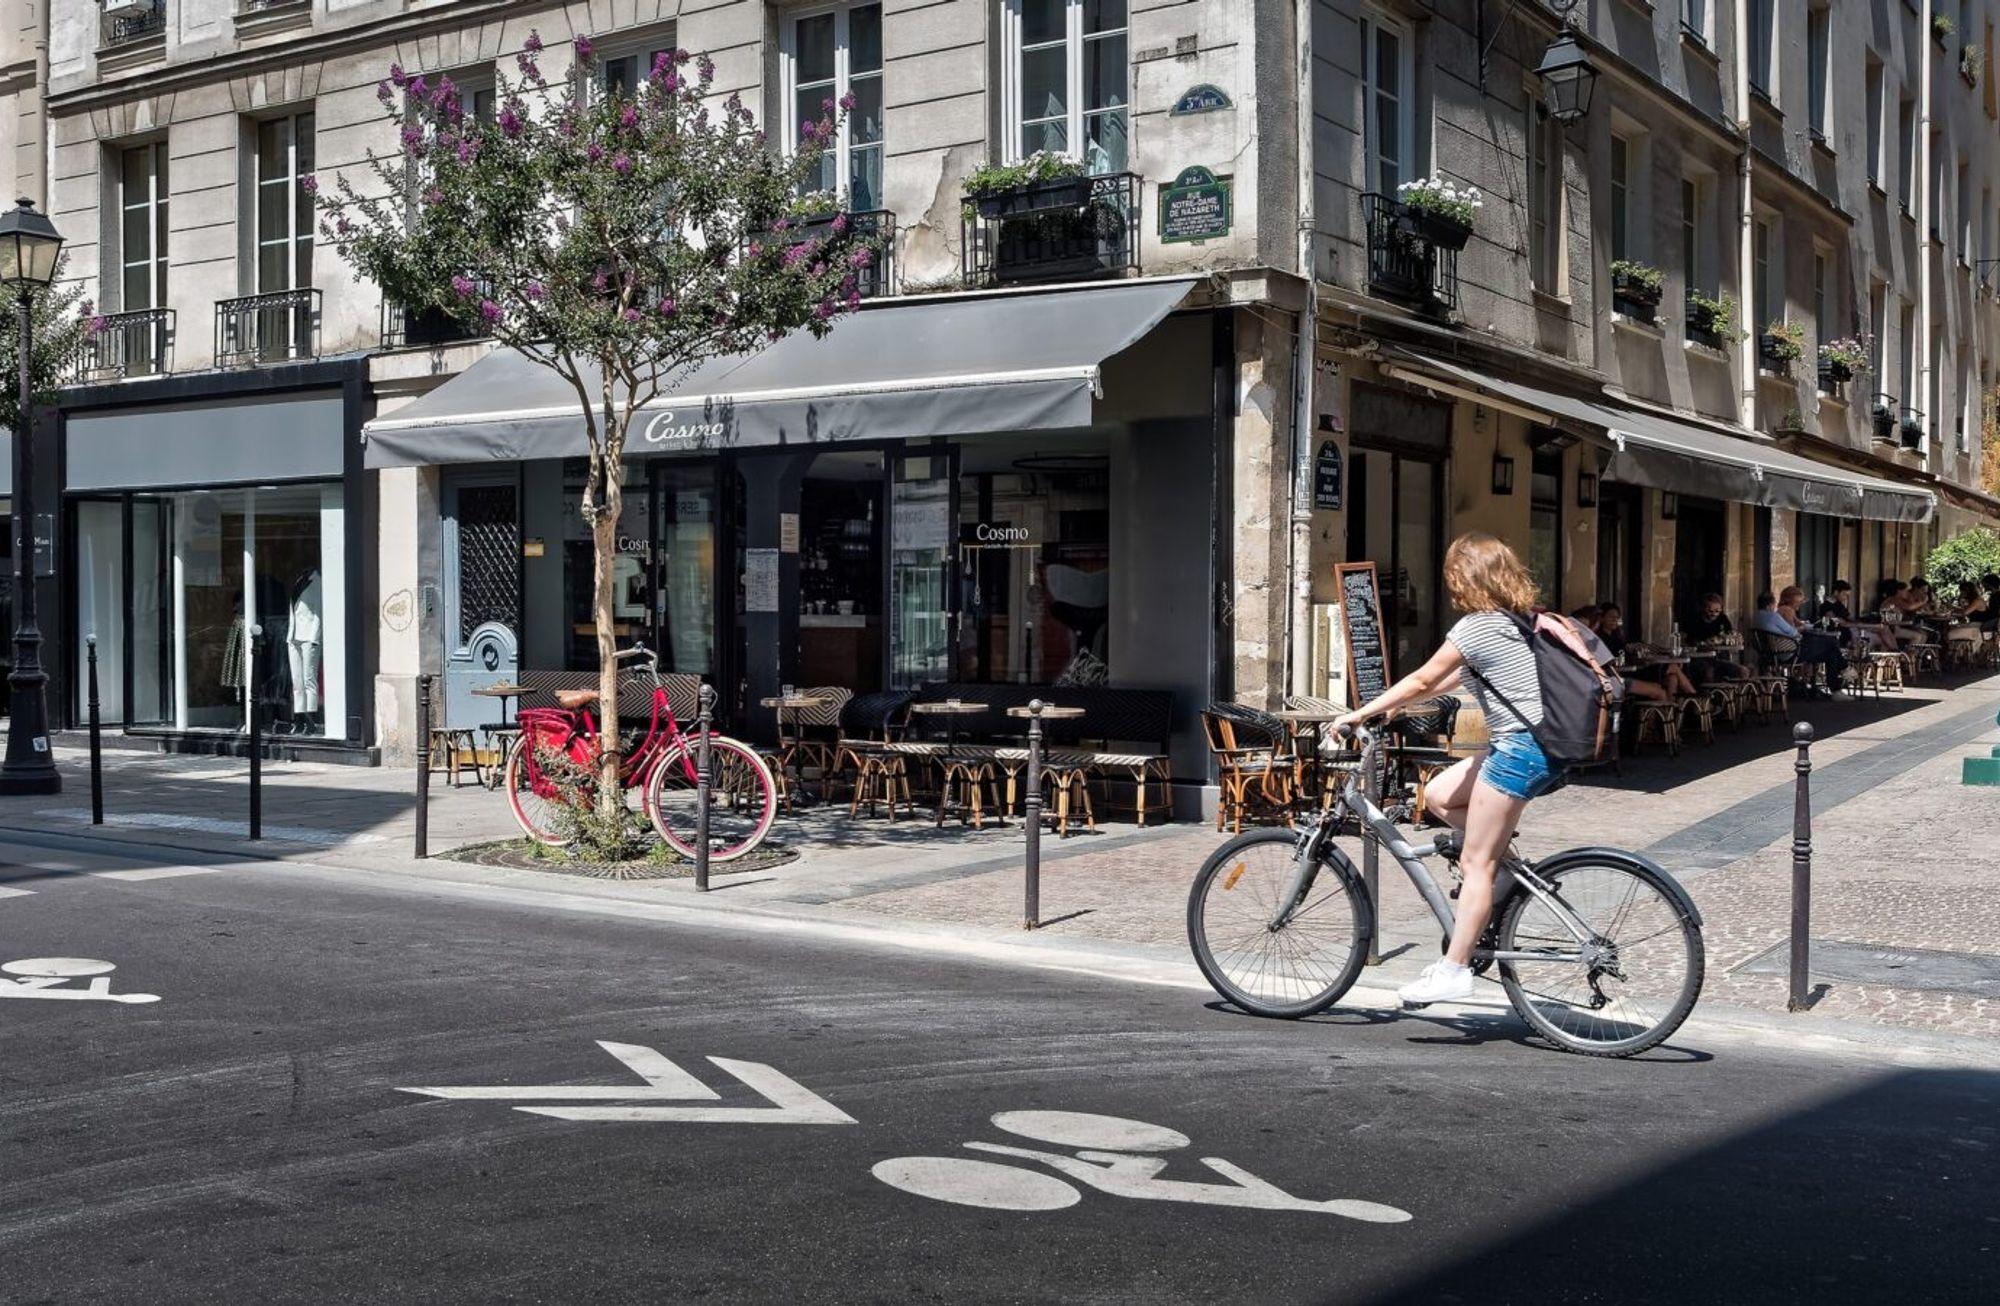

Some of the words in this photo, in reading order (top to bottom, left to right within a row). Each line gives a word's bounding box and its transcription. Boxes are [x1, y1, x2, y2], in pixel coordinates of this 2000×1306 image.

[1169, 209, 1180, 218] DE
[1180, 205, 1220, 216] NAZARETH
[645, 411, 724, 443] Cosmo
[976, 523, 1029, 541] Cosmo
